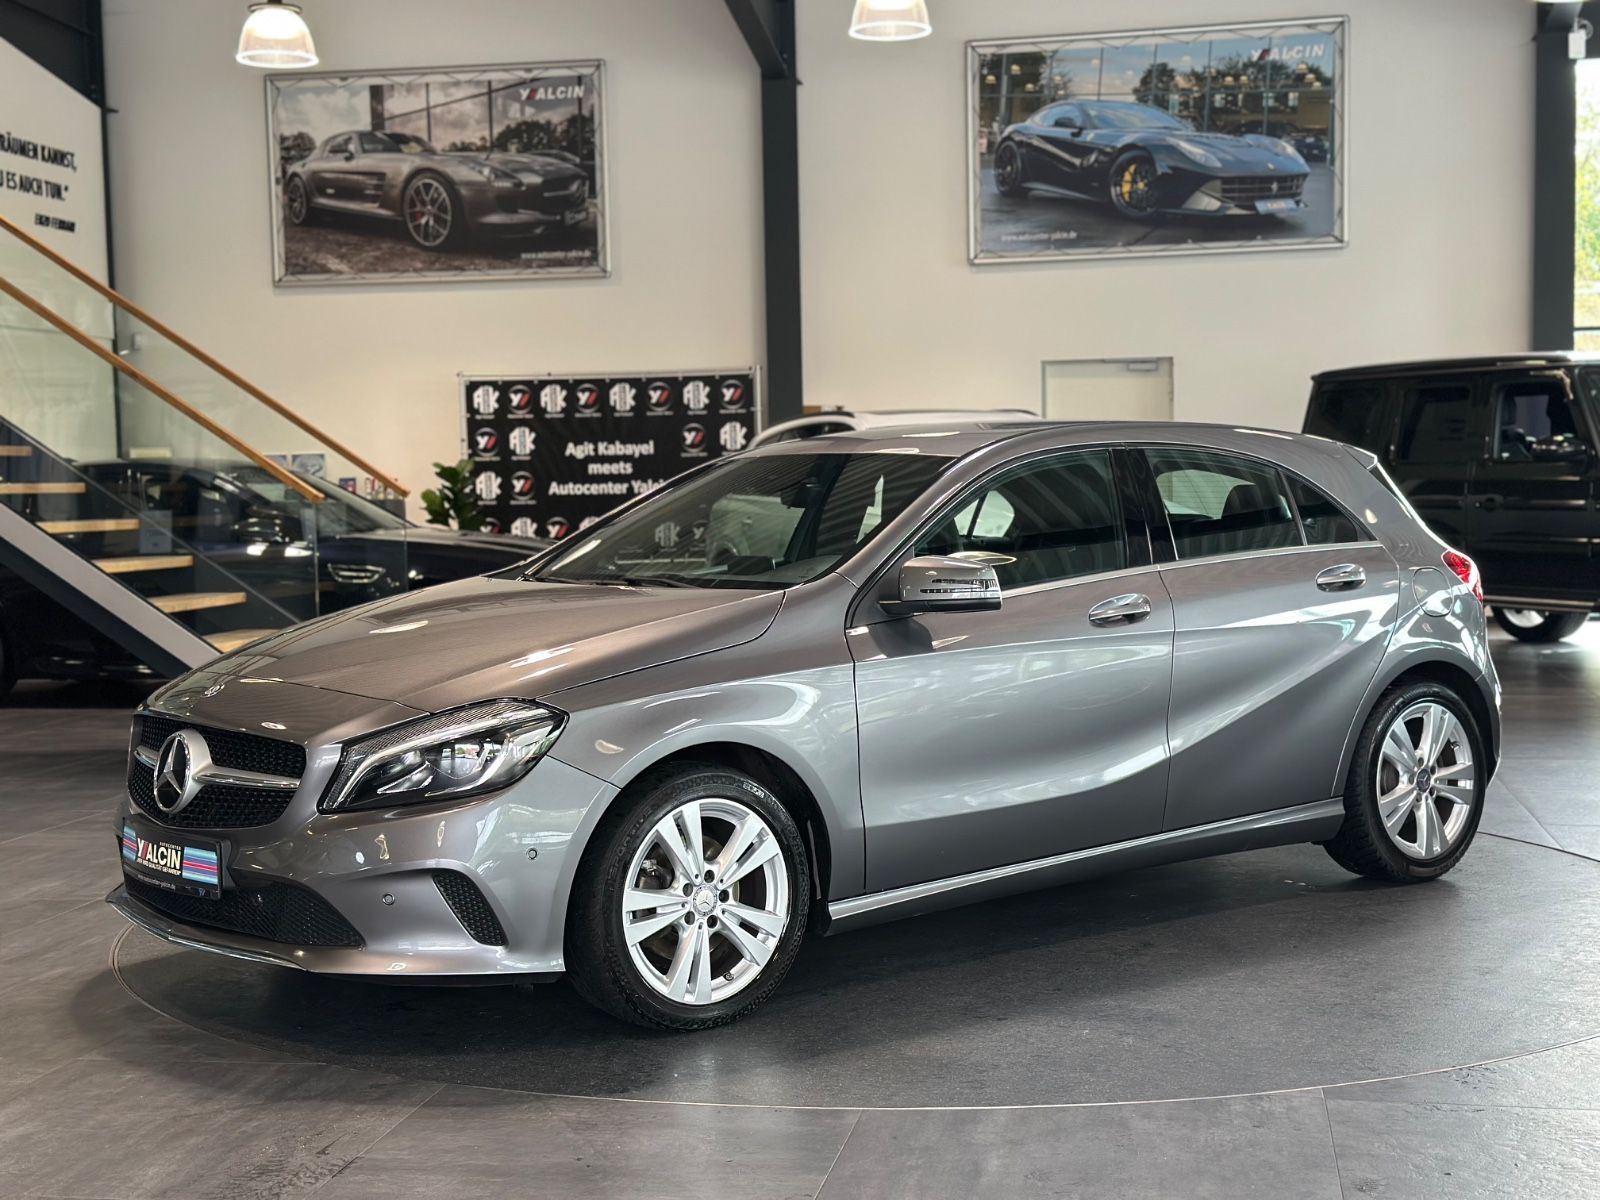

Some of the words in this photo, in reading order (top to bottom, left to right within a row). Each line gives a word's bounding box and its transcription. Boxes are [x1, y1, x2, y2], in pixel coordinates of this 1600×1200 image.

[565, 441, 595, 459] Agit
[597, 440, 654, 458] Kabayel
[588, 461, 633, 475] meets
[548, 480, 628, 496] Autocenter
